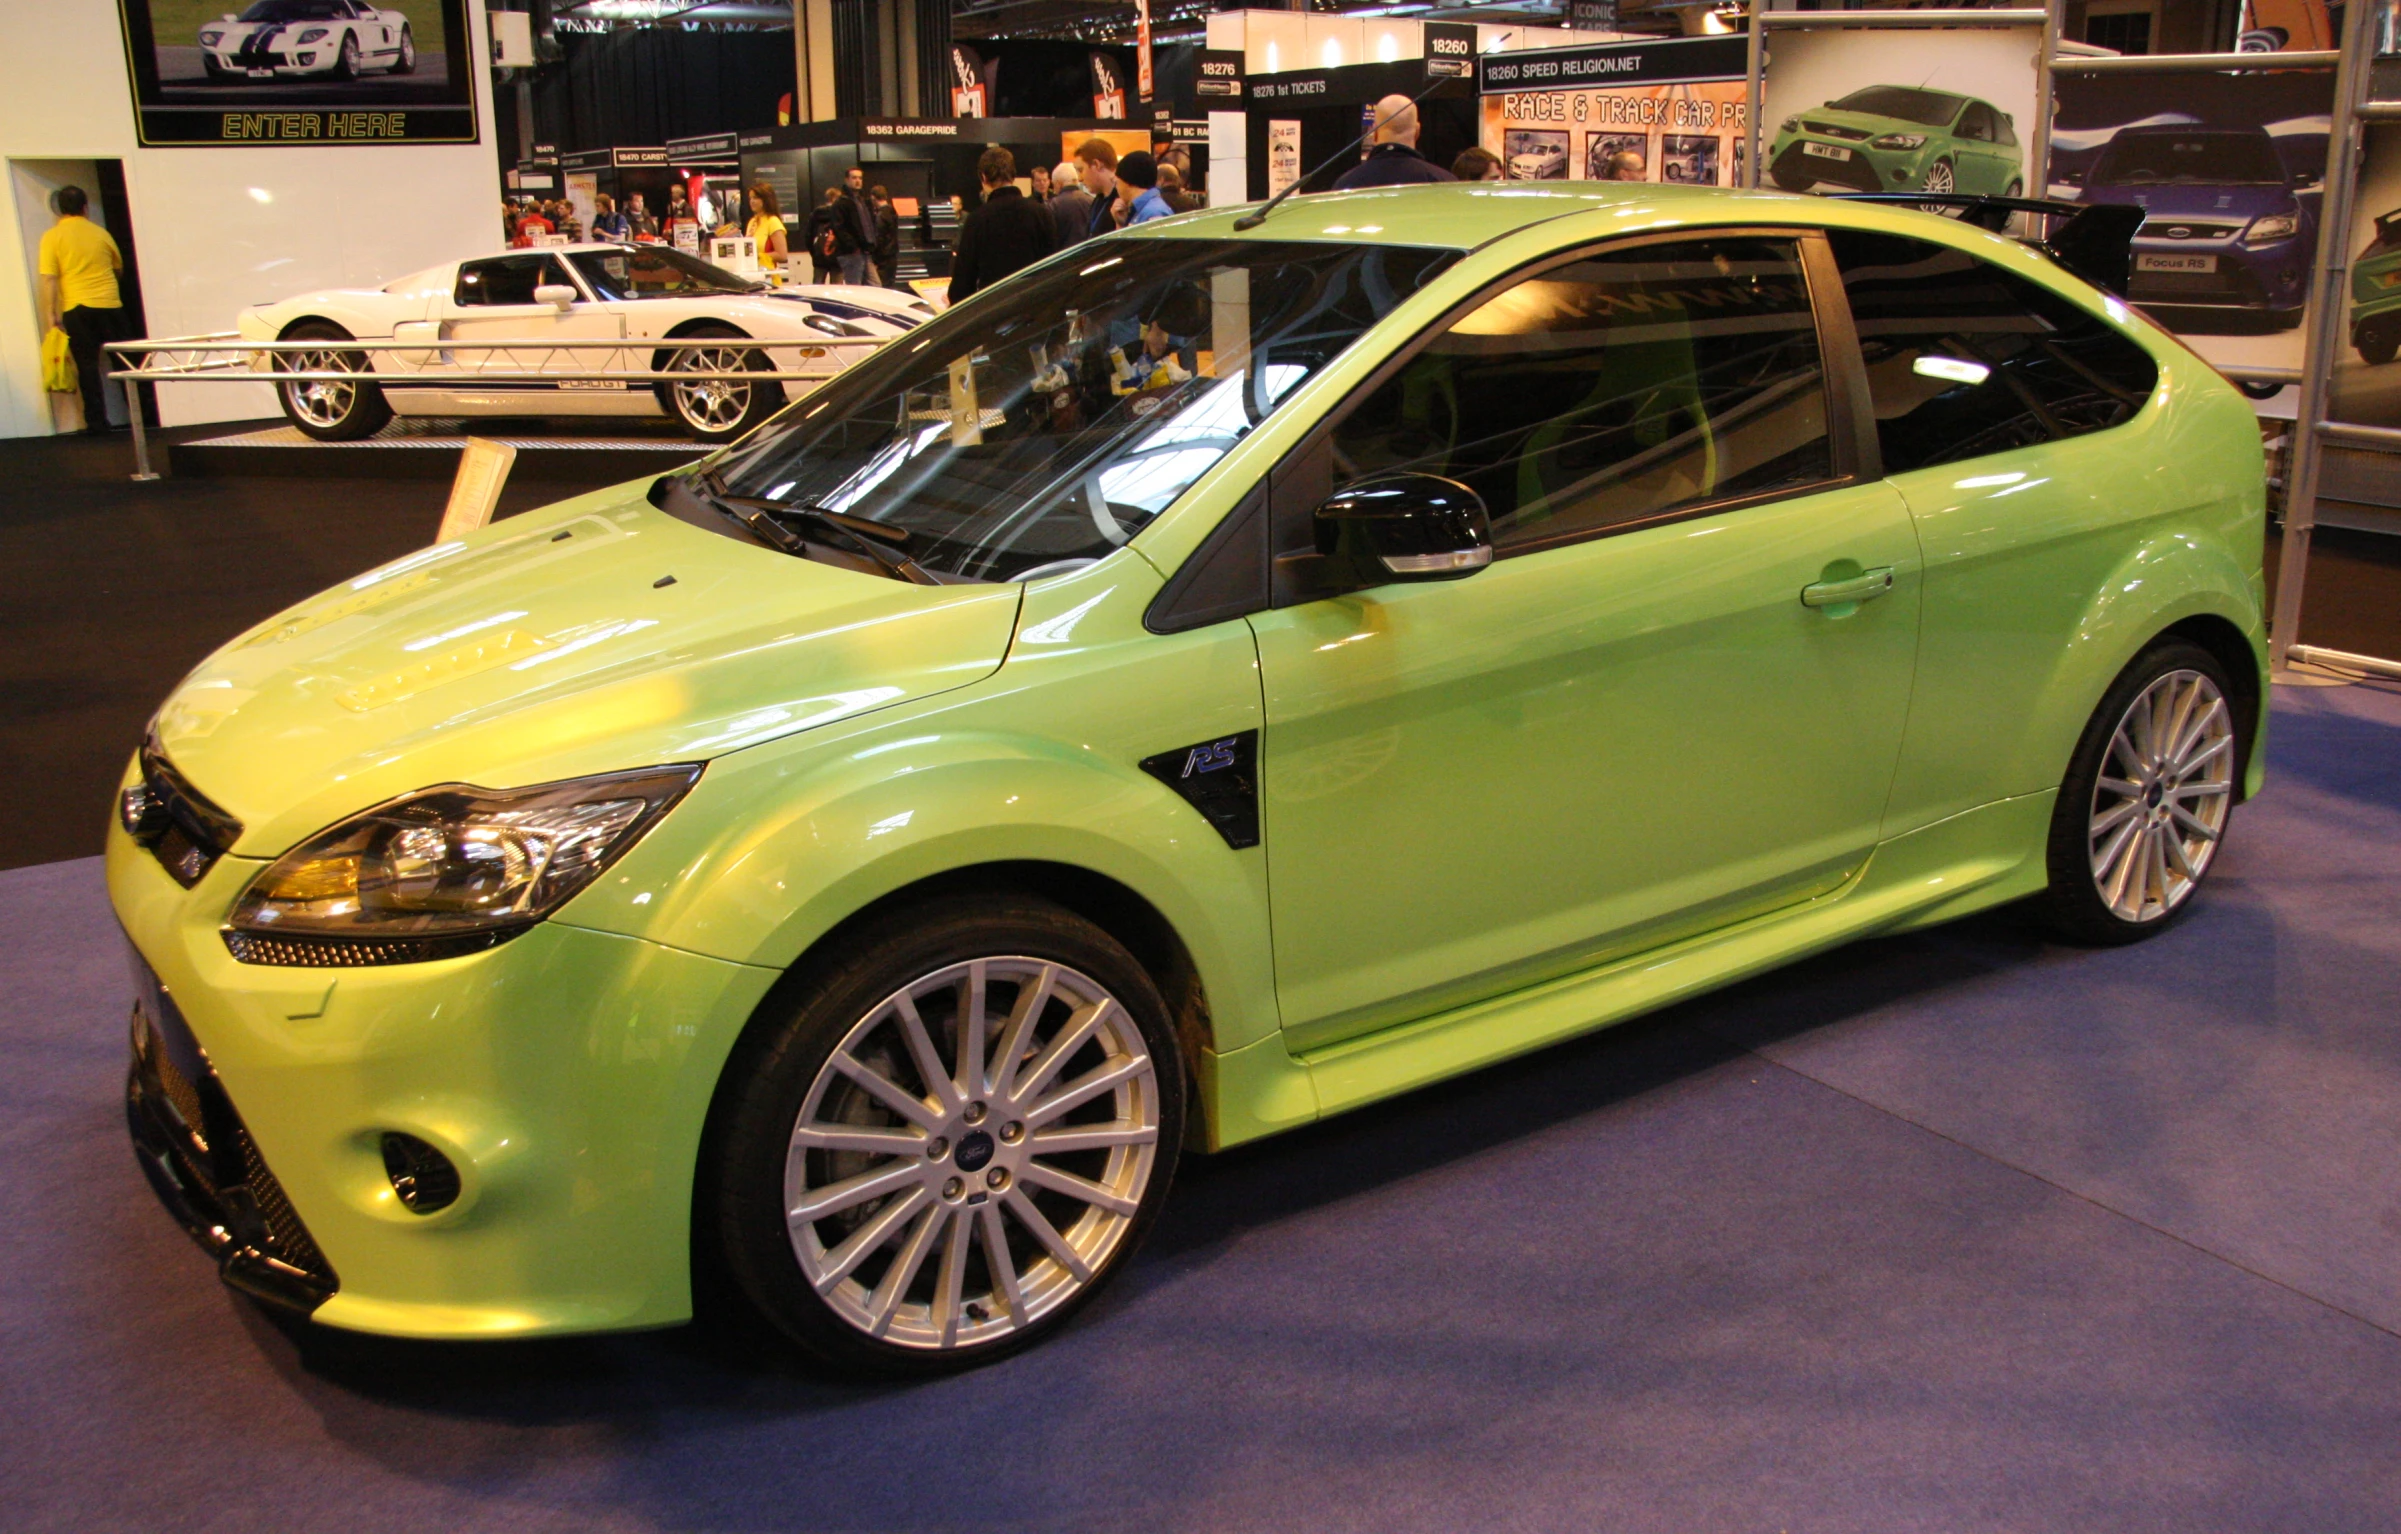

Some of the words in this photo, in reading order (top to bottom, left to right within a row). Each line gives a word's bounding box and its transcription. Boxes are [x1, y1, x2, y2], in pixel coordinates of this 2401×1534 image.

[1574, 3, 1616, 20] ICONIC
[1432, 38, 1468, 55] 18260
[1201, 62, 1236, 76] 18276
[1487, 66, 1518, 80] 18260
[1522, 63, 1558, 78] SPEED
[1562, 56, 1642, 75] RELIGION.NET
[1252, 85, 1275, 98] 18276
[1277, 84, 1289, 96] 1st
[1291, 80, 1326, 94] TICKETS
[1503, 92, 1566, 121] RACE
[1573, 94, 1588, 121] &
[1596, 95, 1668, 125] TRACK
[1674, 100, 1716, 127] CAR
[1721, 101, 1747, 129] PR
[223, 113, 321, 138] ENTER
[328, 113, 406, 137] HERE
[866, 125, 893, 135] 18362
[896, 125, 957, 135] GARAGEPRIDE
[2145, 257, 2184, 268] Focus
[2187, 258, 2206, 269] RS
[1182, 738, 1237, 778] RS
